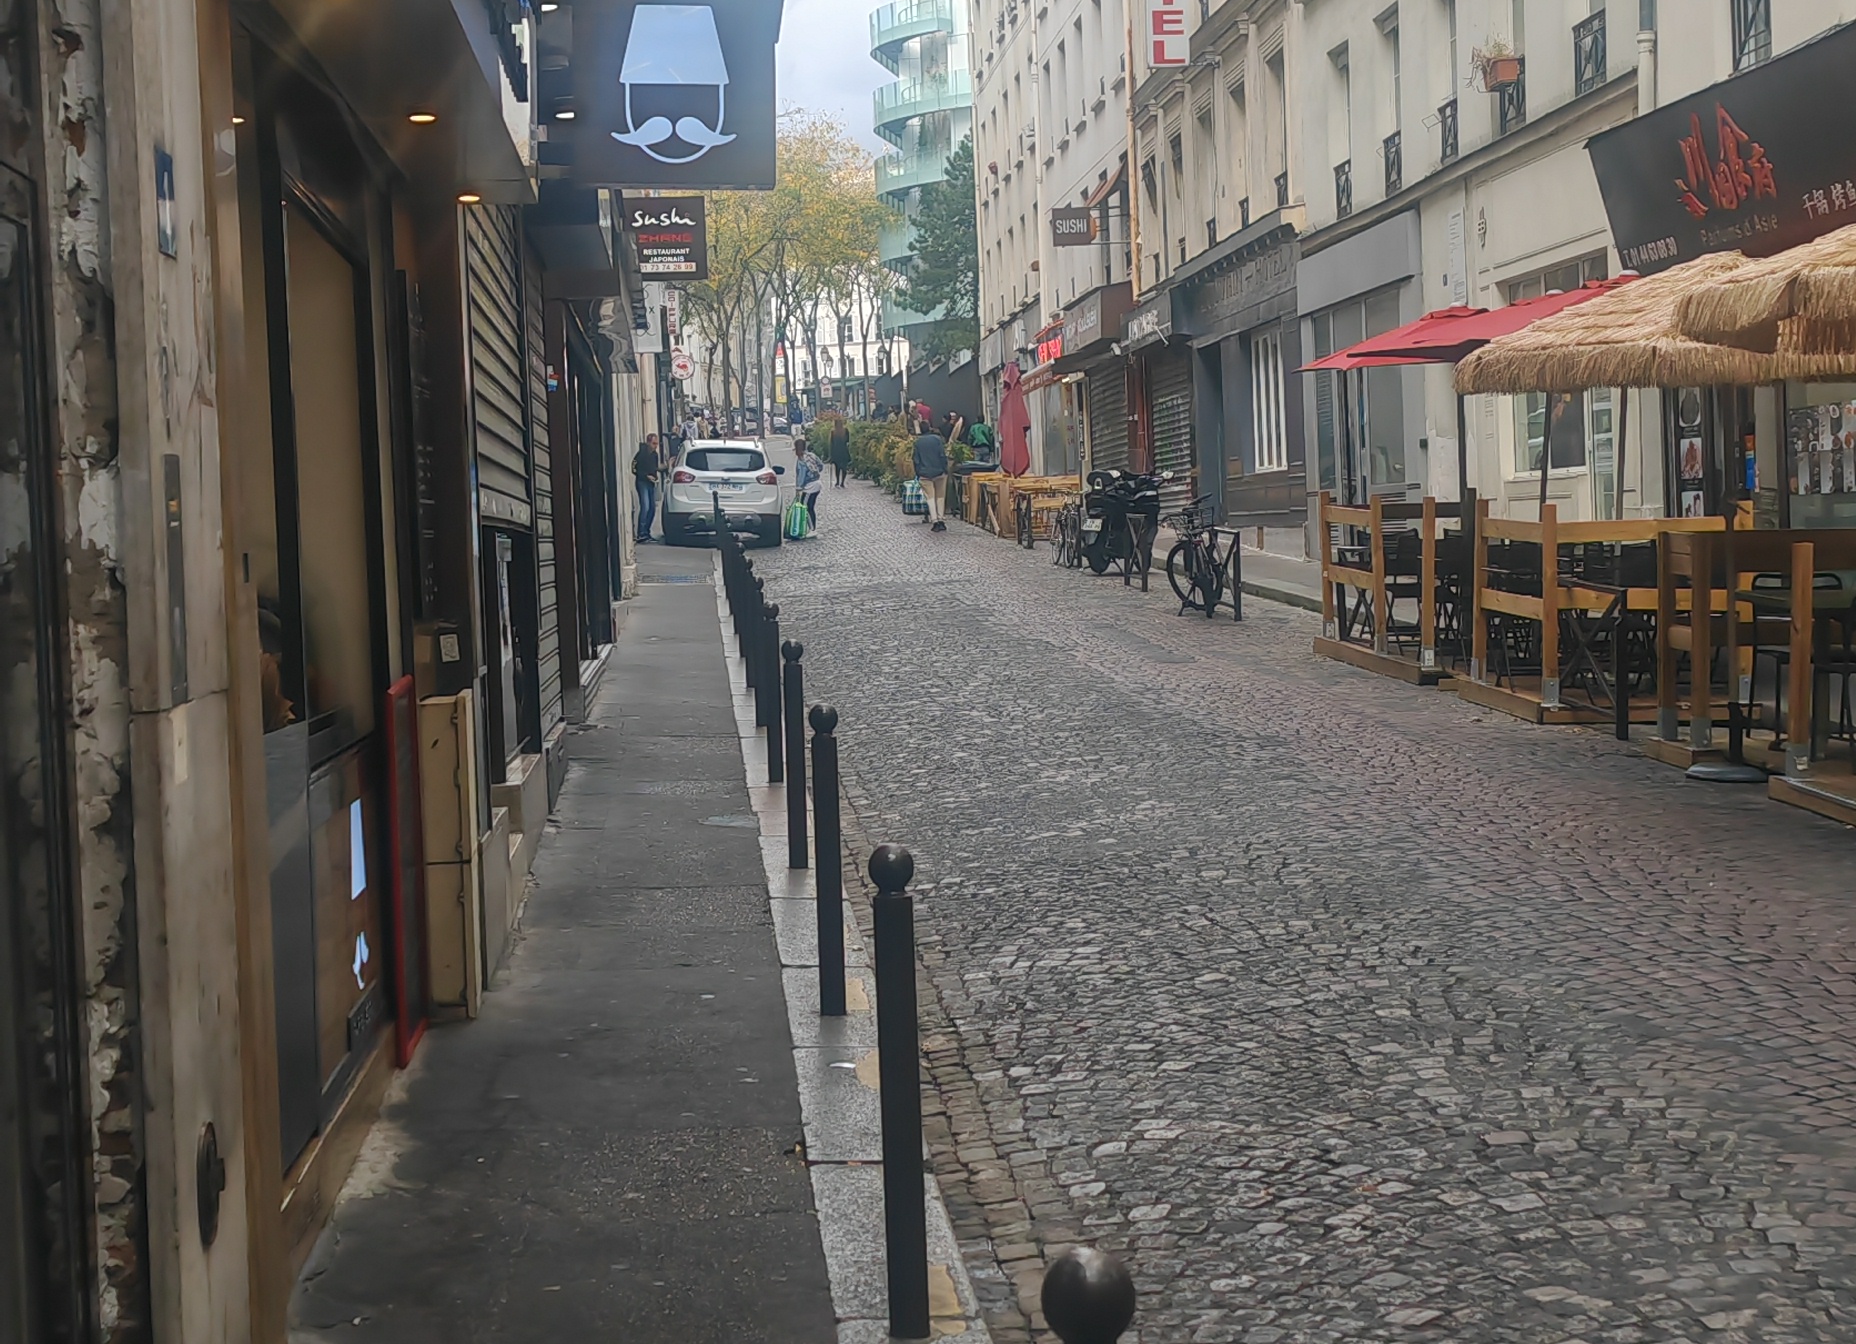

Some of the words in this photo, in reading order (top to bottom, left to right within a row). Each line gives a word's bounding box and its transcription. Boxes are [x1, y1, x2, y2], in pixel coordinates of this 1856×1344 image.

[631, 207, 696, 227] Sushi
[1055, 218, 1087, 234] SUSHI
[643, 248, 690, 256] RESTAURANT
